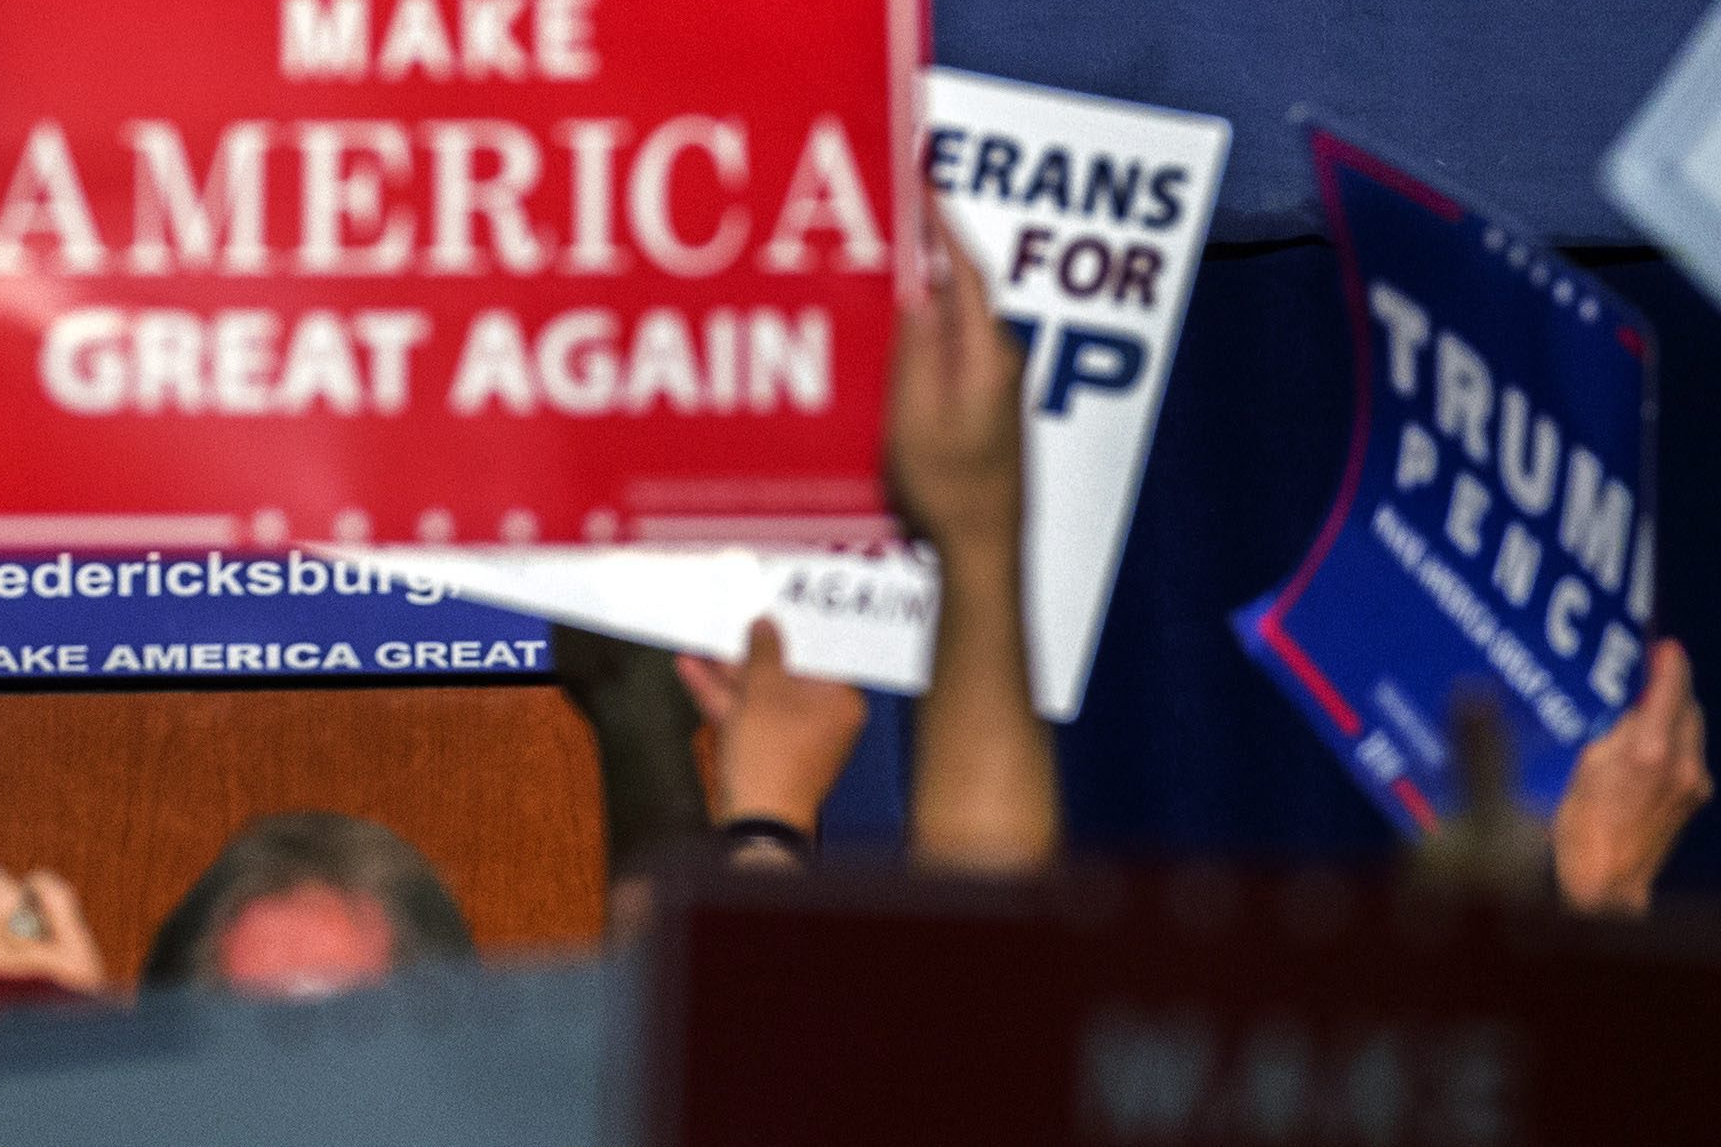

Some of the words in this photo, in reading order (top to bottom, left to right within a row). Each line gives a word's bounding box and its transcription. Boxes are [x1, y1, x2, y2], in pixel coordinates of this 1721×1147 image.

[923, 126, 1190, 229] ERANS
[1007, 227, 1163, 309] FOR
[38, 307, 432, 417] GREAT
[450, 307, 834, 417] AGAIN
[1395, 421, 1642, 707] PENCE
[102, 641, 363, 673] AMERICA
[375, 638, 548, 670] GREAT
